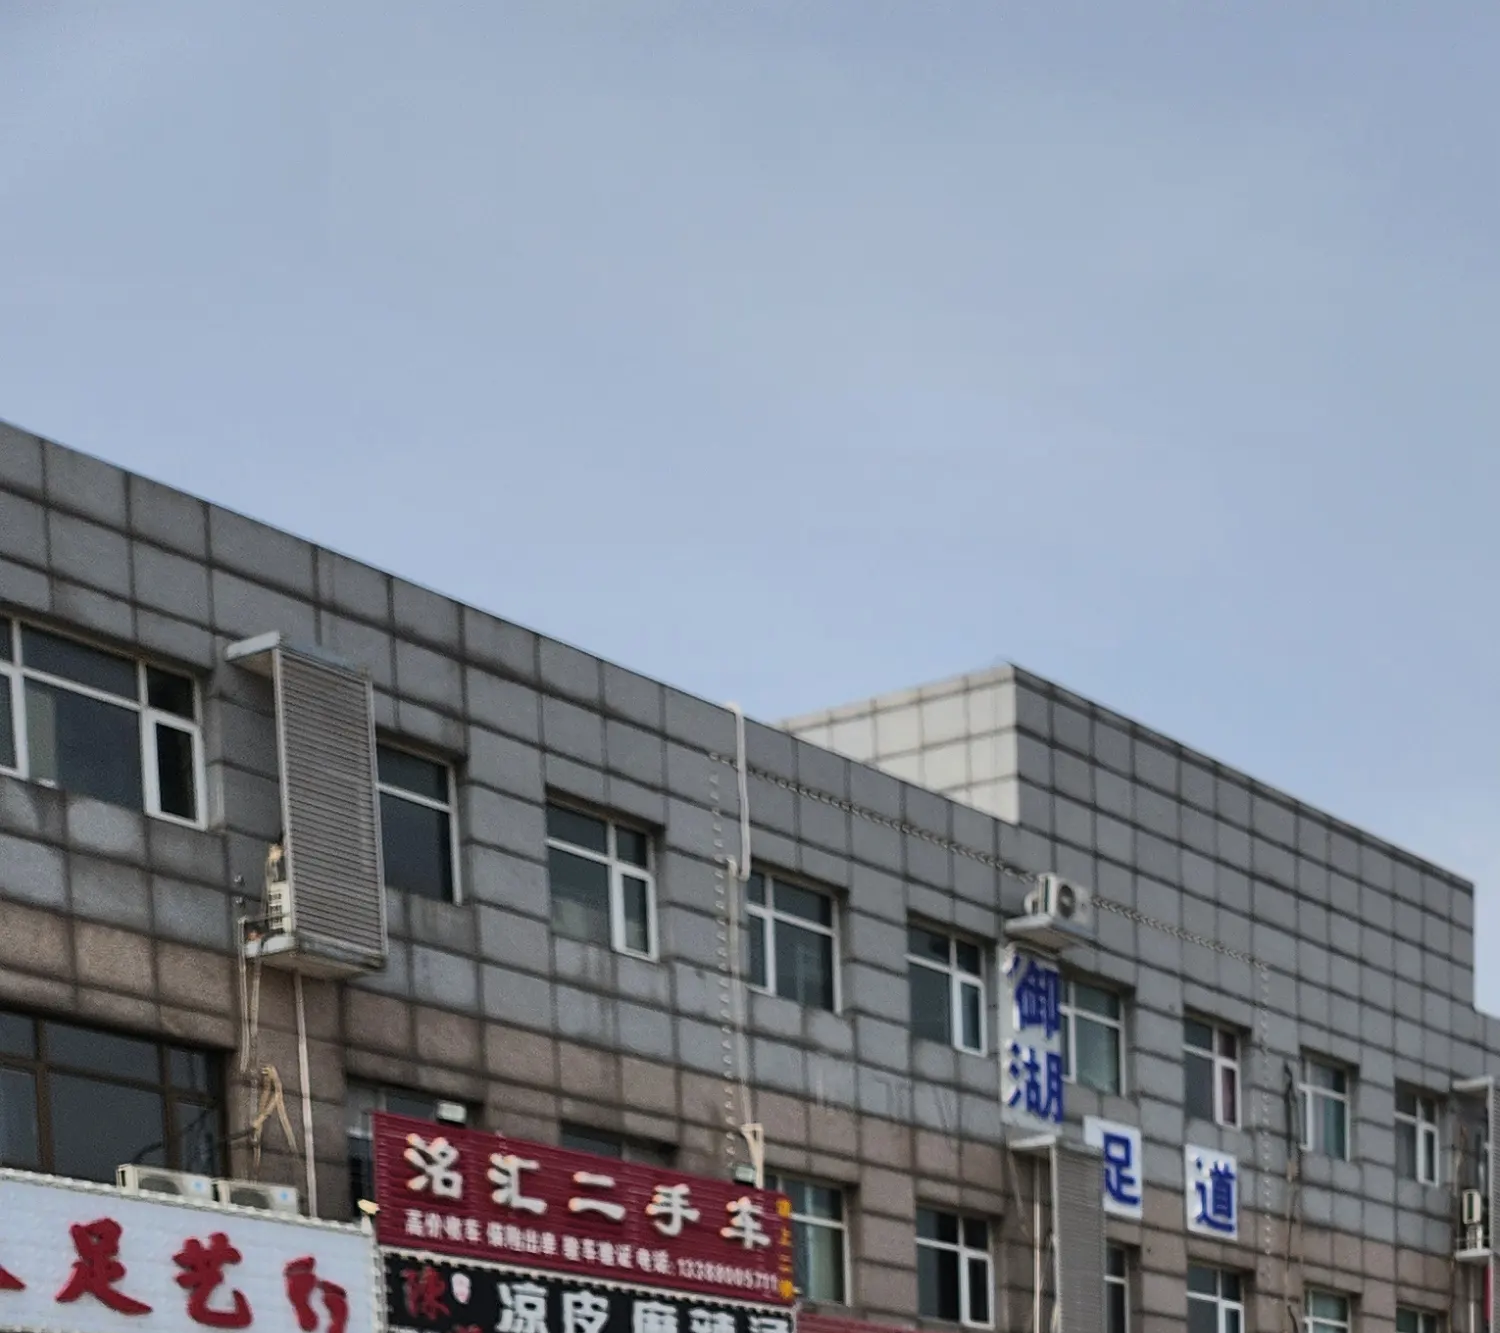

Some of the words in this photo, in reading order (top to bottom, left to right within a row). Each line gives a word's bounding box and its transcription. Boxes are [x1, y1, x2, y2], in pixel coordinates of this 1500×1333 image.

[1006, 954, 1063, 1123] 御湖
[404, 1132, 771, 1249] 洛汇二手车
[0, 1217, 252, 1329] 足艺
